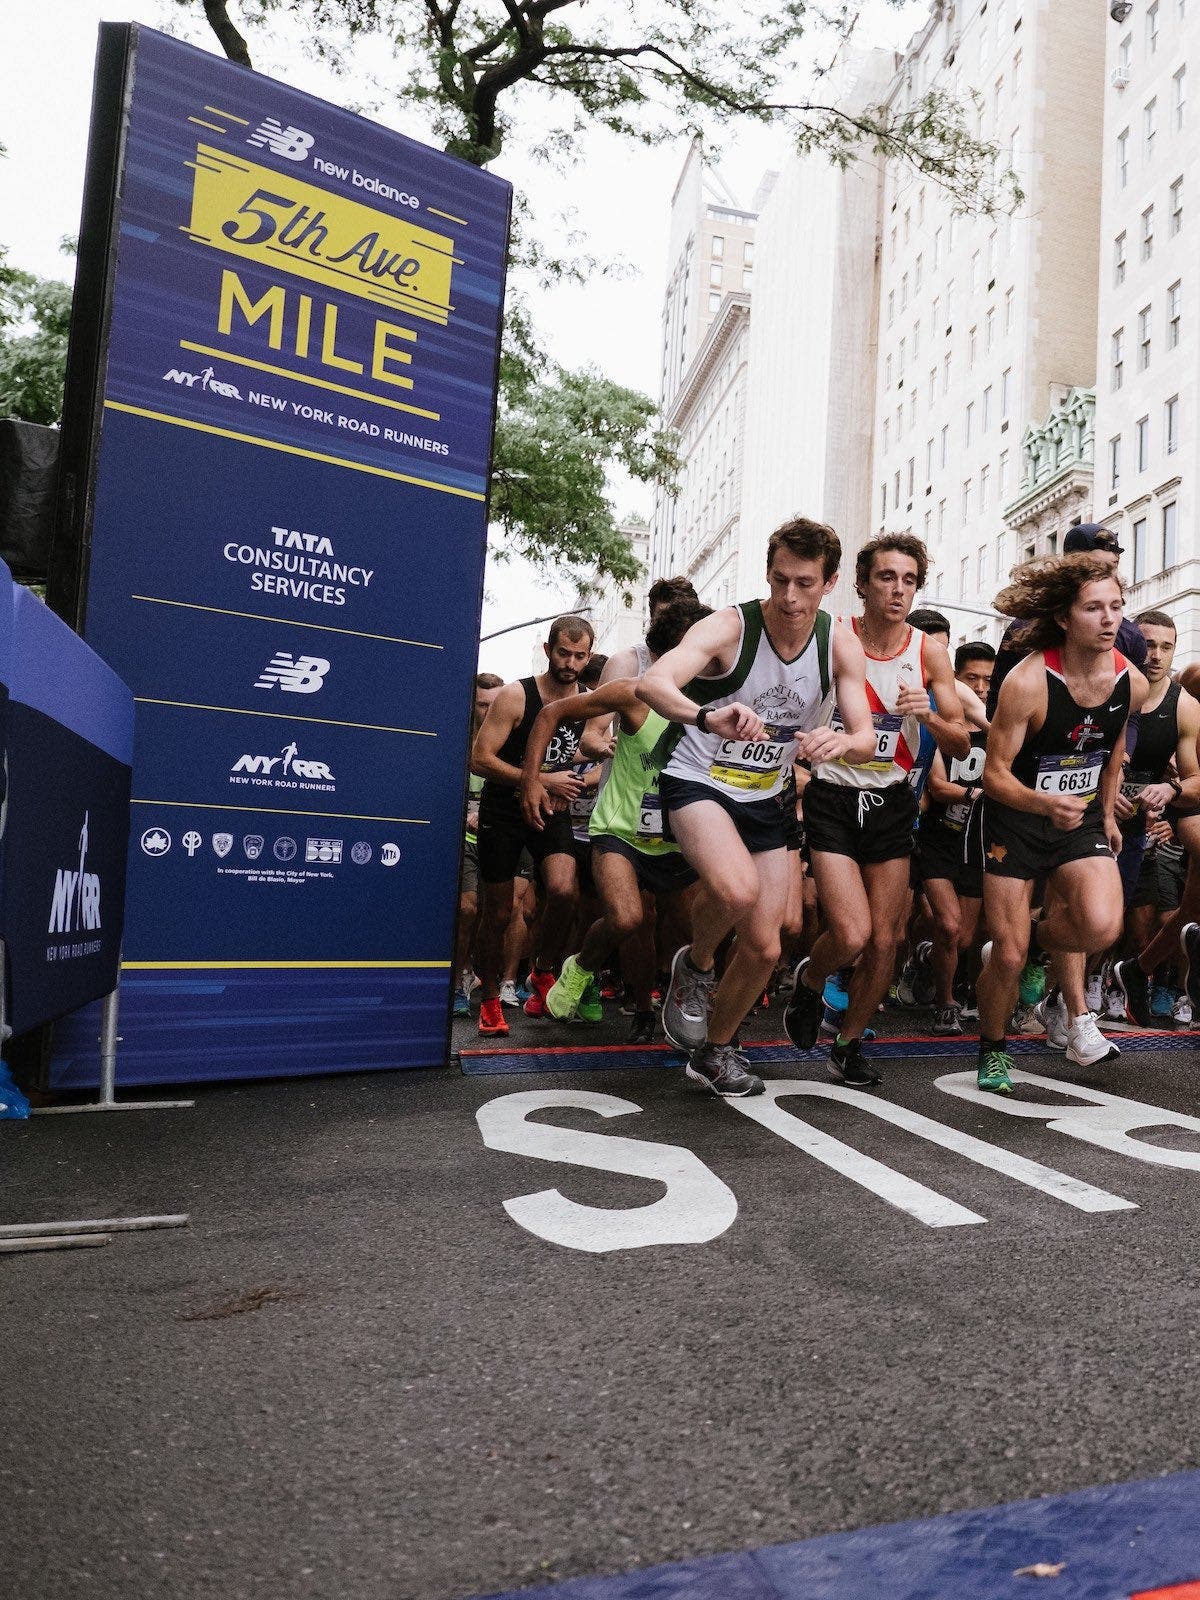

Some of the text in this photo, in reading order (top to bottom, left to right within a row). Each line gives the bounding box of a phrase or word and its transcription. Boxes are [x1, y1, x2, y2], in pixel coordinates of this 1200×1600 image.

[246, 116, 420, 210] NB new balance
[221, 188, 420, 291] 5th Ave.
[217, 269, 419, 391] MILE
[248, 391, 289, 413] NEW
[291, 402, 335, 426] YORK
[337, 414, 381, 438] ROAD
[383, 426, 450, 457] RUNNERS
[271, 526, 335, 557] TATA
[223, 542, 374, 587] CONSULTANCY
[250, 571, 346, 606] SERVICES
[253, 651, 331, 694] NB
[722, 740, 784, 764] C 6054
[229, 776, 336, 792] NEW YORK ROAD RUNNERS
[1040, 770, 1092, 792] C 6631
